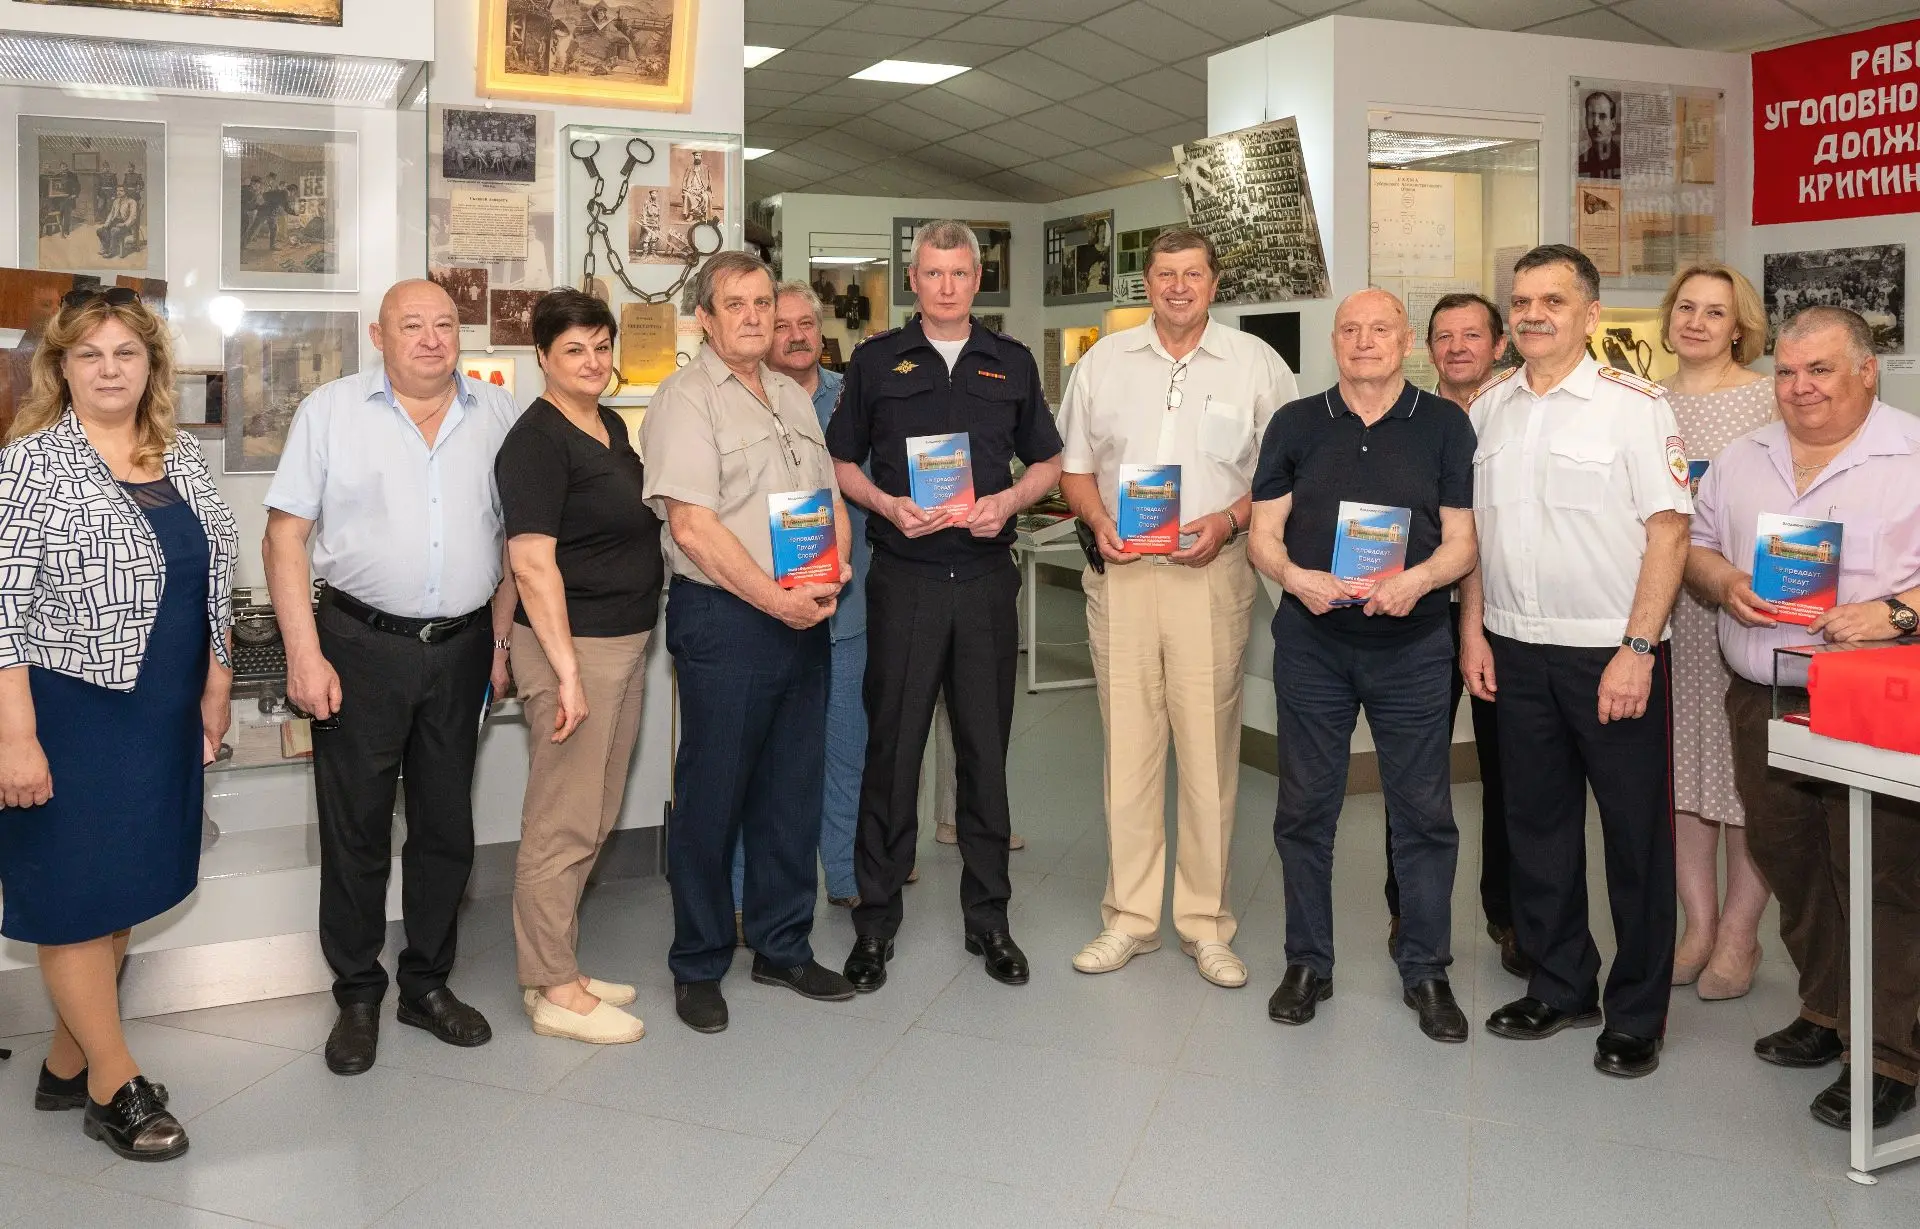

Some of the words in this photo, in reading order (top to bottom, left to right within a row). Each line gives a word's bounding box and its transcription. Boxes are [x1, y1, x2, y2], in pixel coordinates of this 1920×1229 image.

[1851, 40, 1920, 80] РАБ
[1764, 82, 1918, 131] УГОЛОВНО
[1814, 122, 1920, 166] ДОЛЖ
[1799, 162, 1920, 204] КРИМИН
